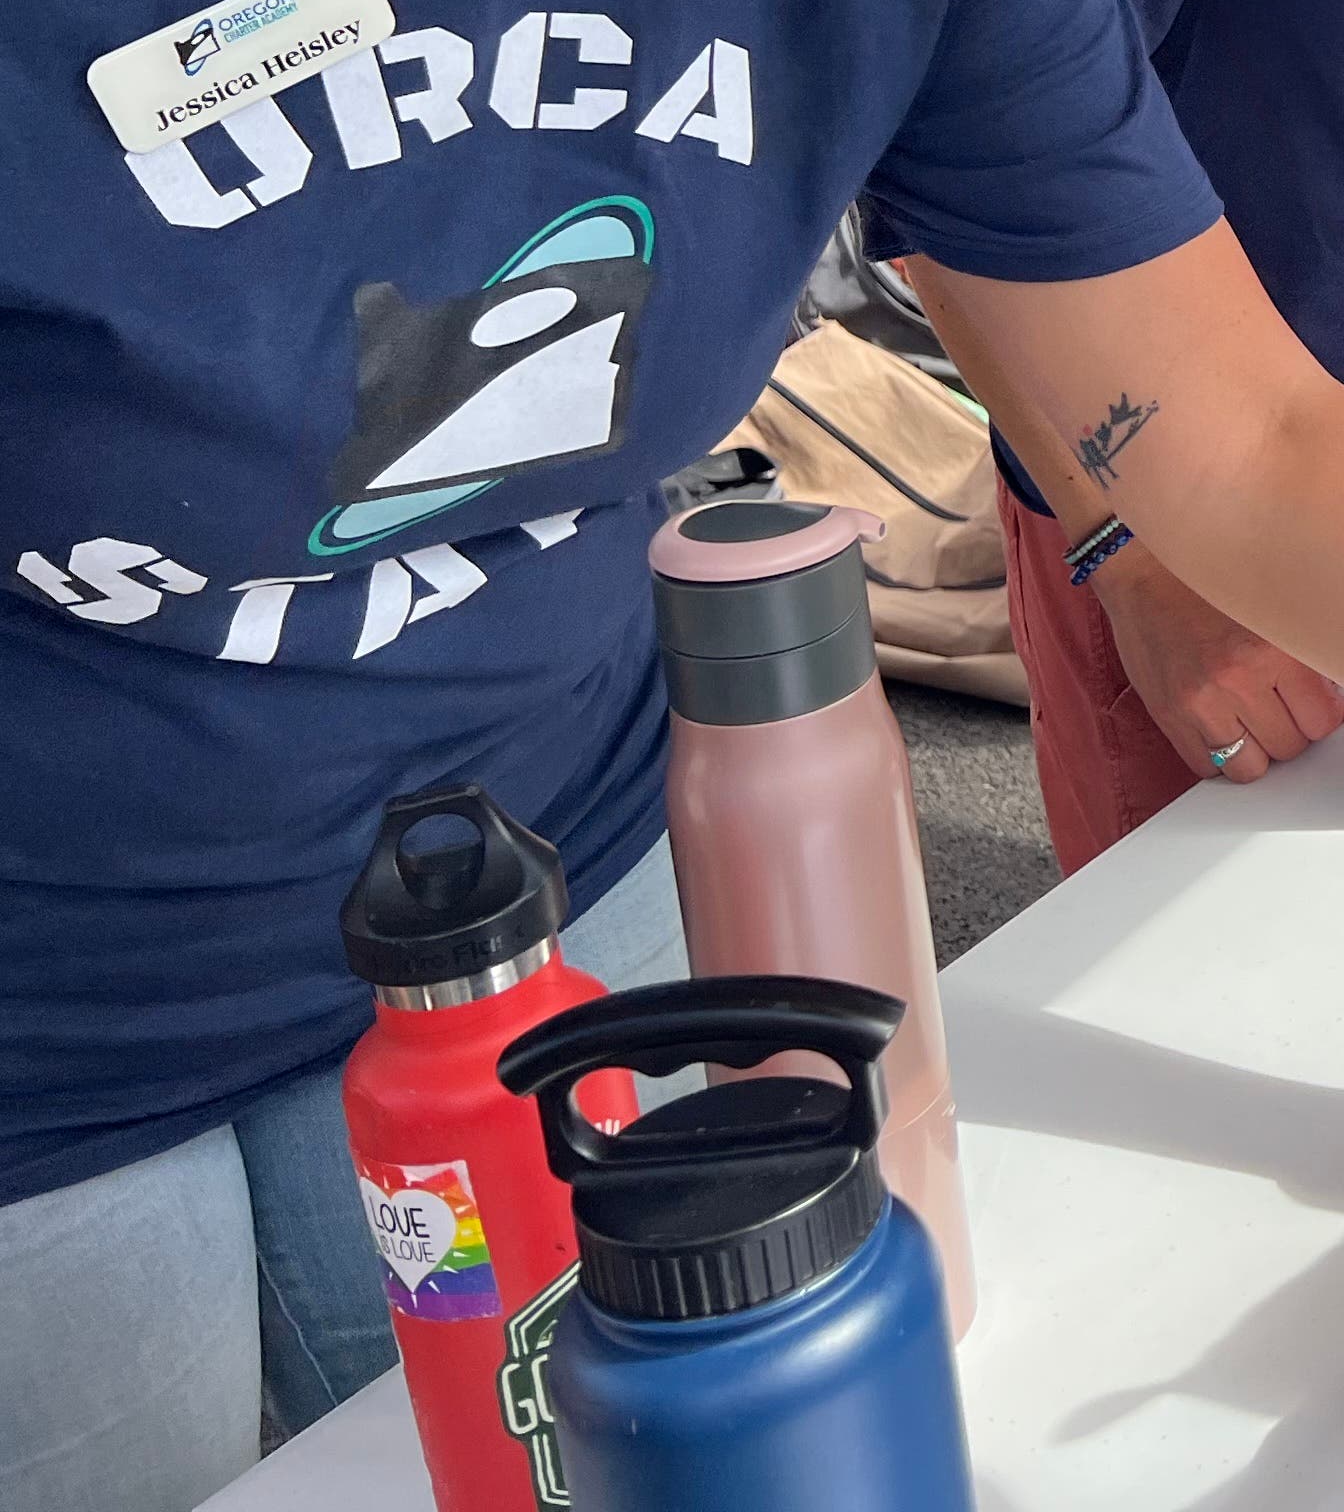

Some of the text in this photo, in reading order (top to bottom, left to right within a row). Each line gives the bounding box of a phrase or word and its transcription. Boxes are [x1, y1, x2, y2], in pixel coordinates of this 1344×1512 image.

[223, 2, 299, 43] CHARTER ACADEMY
[156, 20, 361, 131] Jessica Heisley
[369, 1195, 430, 1238] LOVE
[390, 1239, 437, 1263] LOVE
